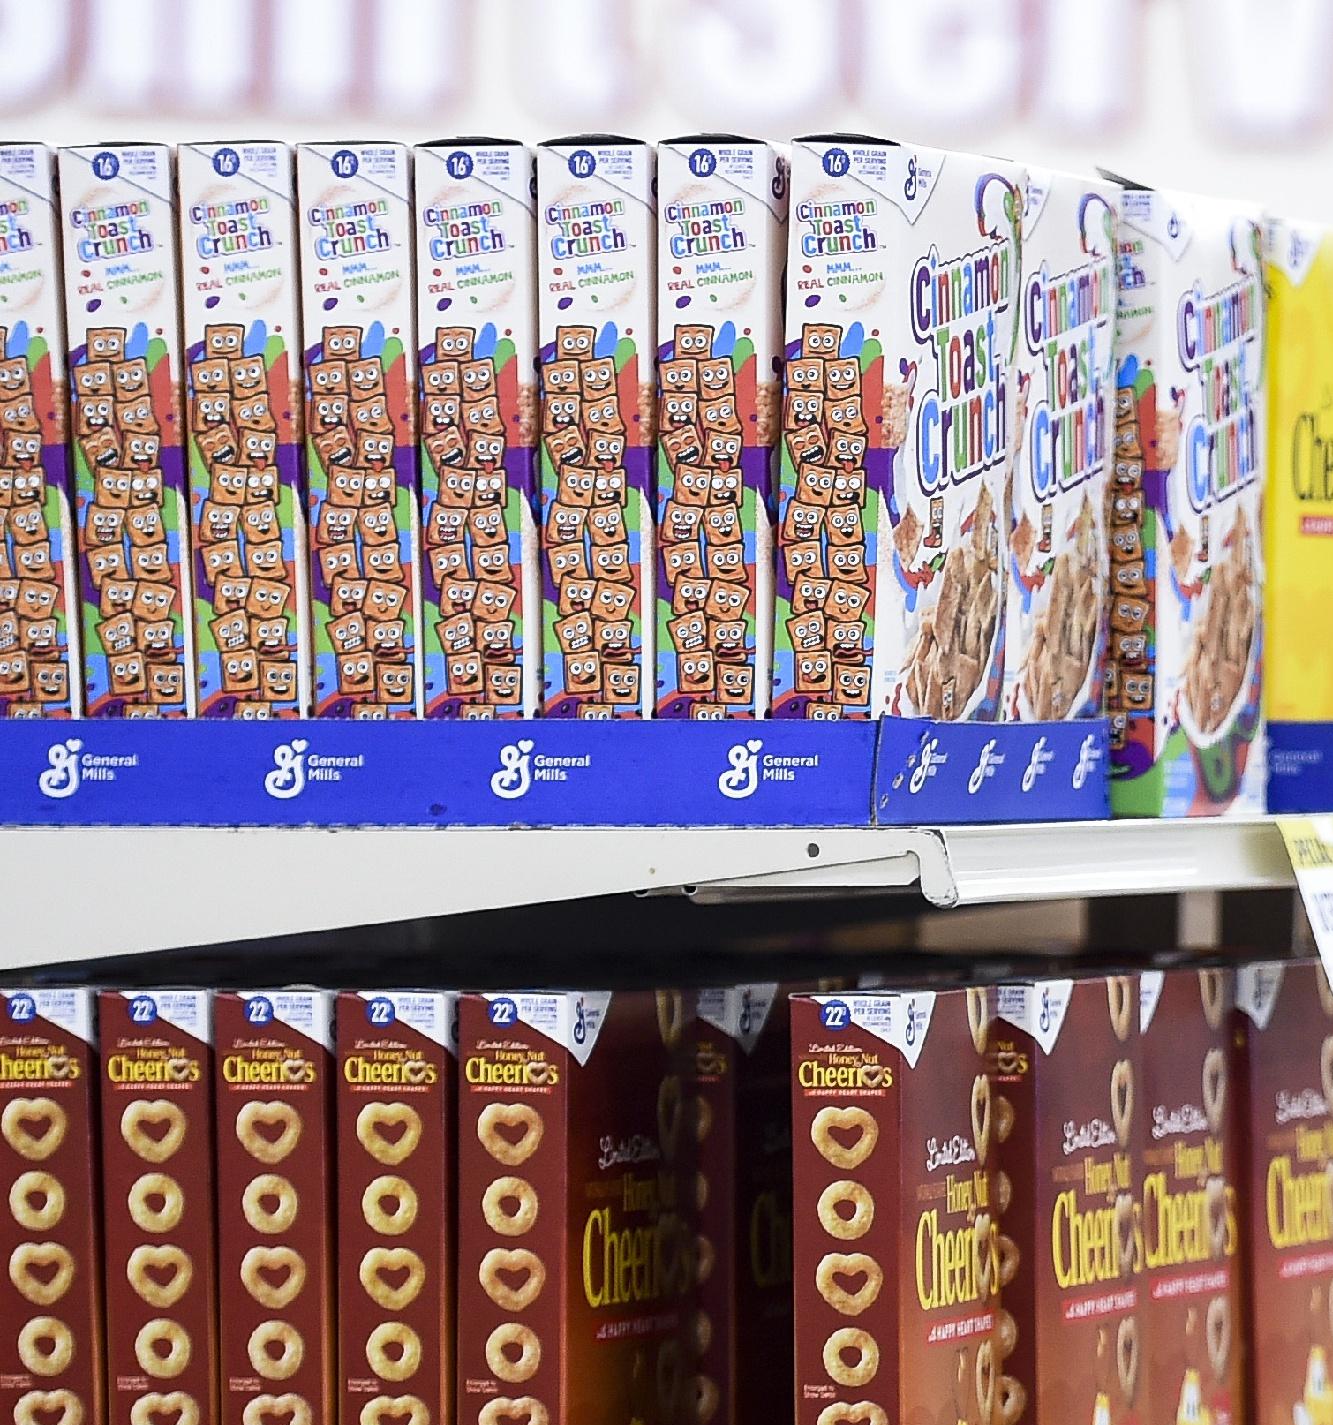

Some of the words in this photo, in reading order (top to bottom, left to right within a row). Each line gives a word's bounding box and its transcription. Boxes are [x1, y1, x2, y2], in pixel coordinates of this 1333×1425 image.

[426, 201, 502, 225] Cinnamon
[547, 200, 624, 223] Cinnamon
[667, 199, 744, 221] Cinnamon
[799, 199, 876, 221] Cinnamon
[442, 216, 489, 239] Toast
[563, 215, 612, 237] Toast
[683, 215, 731, 237] Toast
[815, 215, 863, 237] Toast
[431, 230, 504, 258] Crunch
[551, 229, 626, 258] Crunch
[671, 229, 745, 256] Crunch
[803, 229, 876, 256] Crunch
[914, 246, 1010, 332] Cinnamon
[936, 309, 998, 399] Toast
[920, 371, 1008, 484] Crunch
[82, 753, 138, 767] General
[308, 753, 364, 768] General
[534, 753, 590, 768] General
[763, 753, 819, 768] General
[83, 768, 114, 782] Mills
[309, 768, 341, 782] Mills
[535, 768, 567, 782] Mills
[763, 768, 795, 782] Mills
[861, 1053, 879, 1064] Nut
